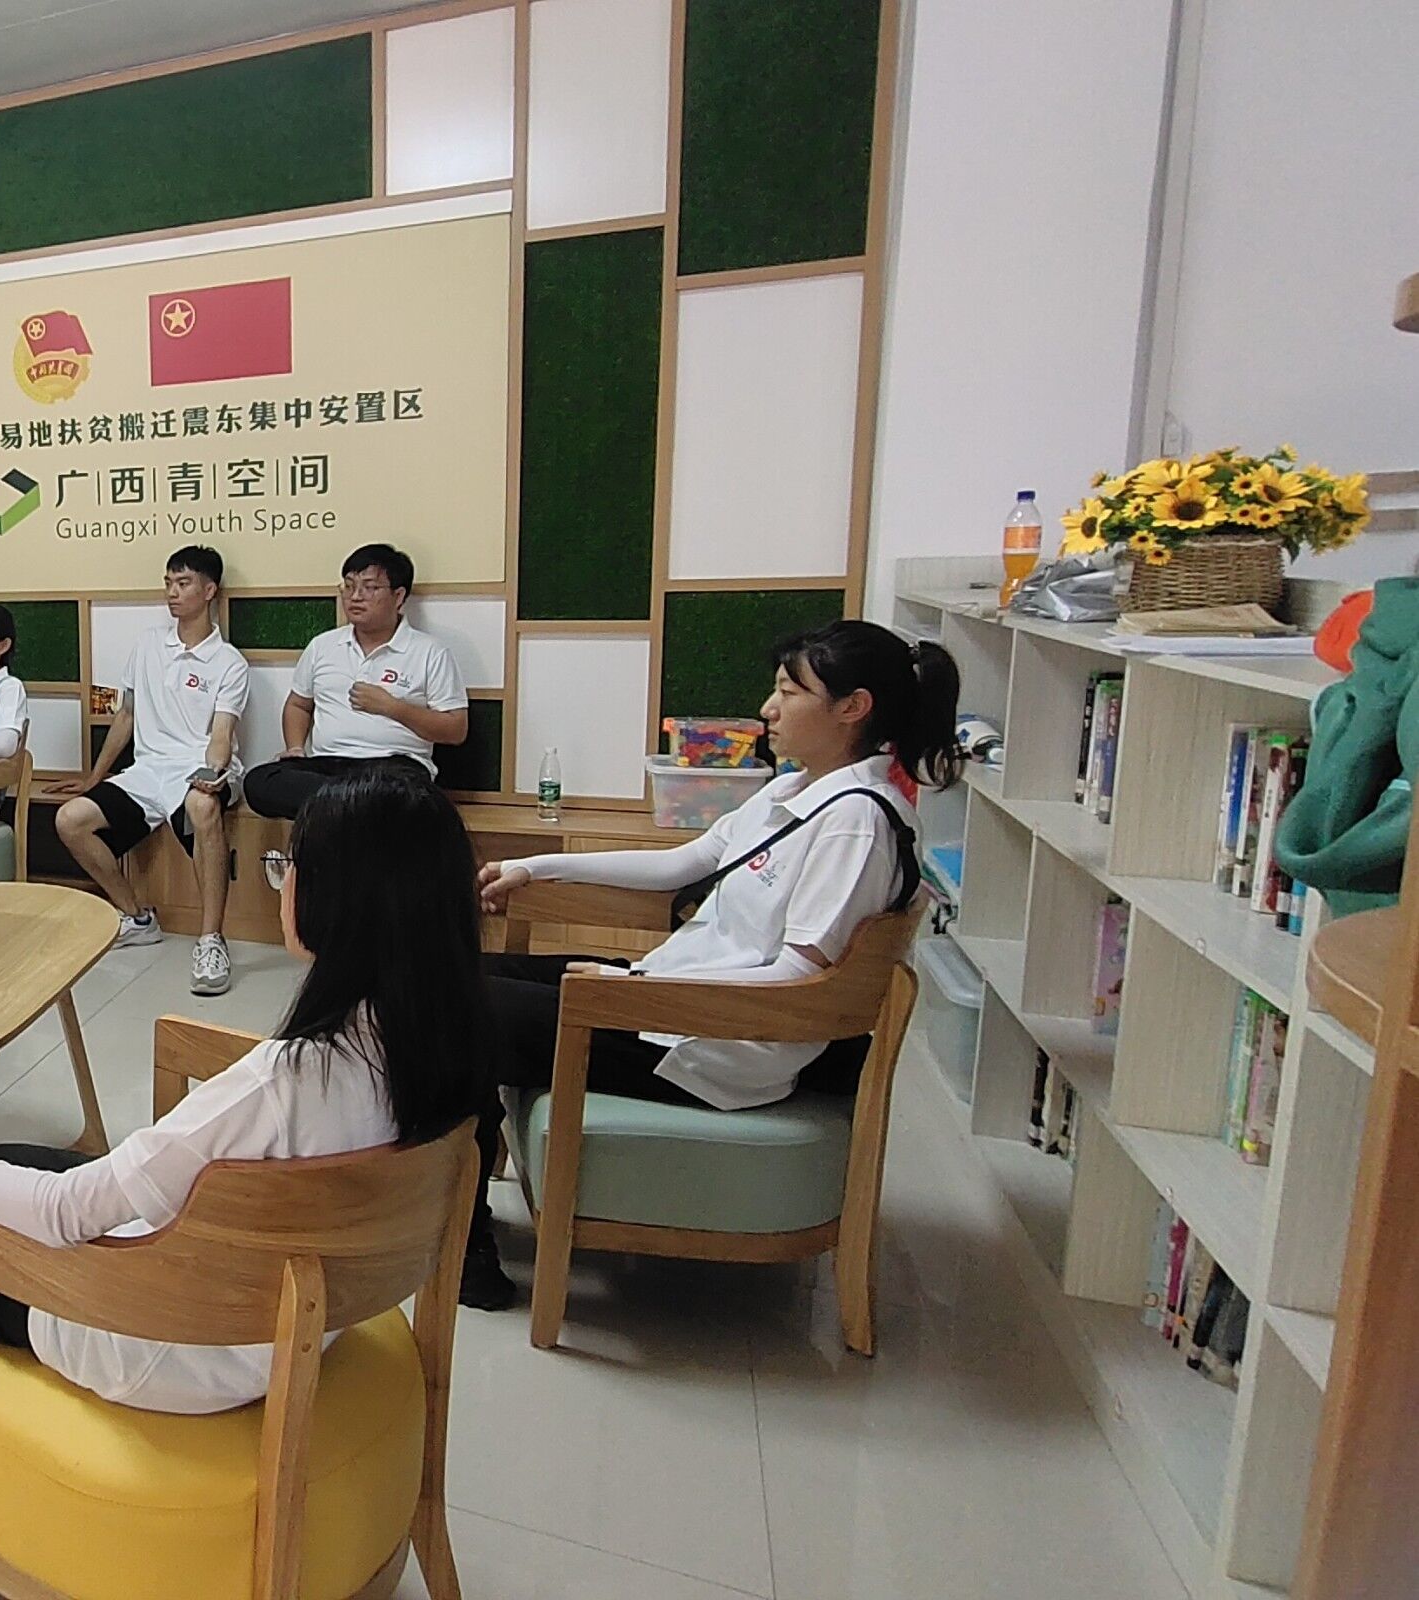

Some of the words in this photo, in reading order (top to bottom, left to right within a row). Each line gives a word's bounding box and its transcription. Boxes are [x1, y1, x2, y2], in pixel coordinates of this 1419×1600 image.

[55, 513, 157, 543] Guangxi
[167, 509, 243, 534] Youth
[254, 508, 337, 537] Space
